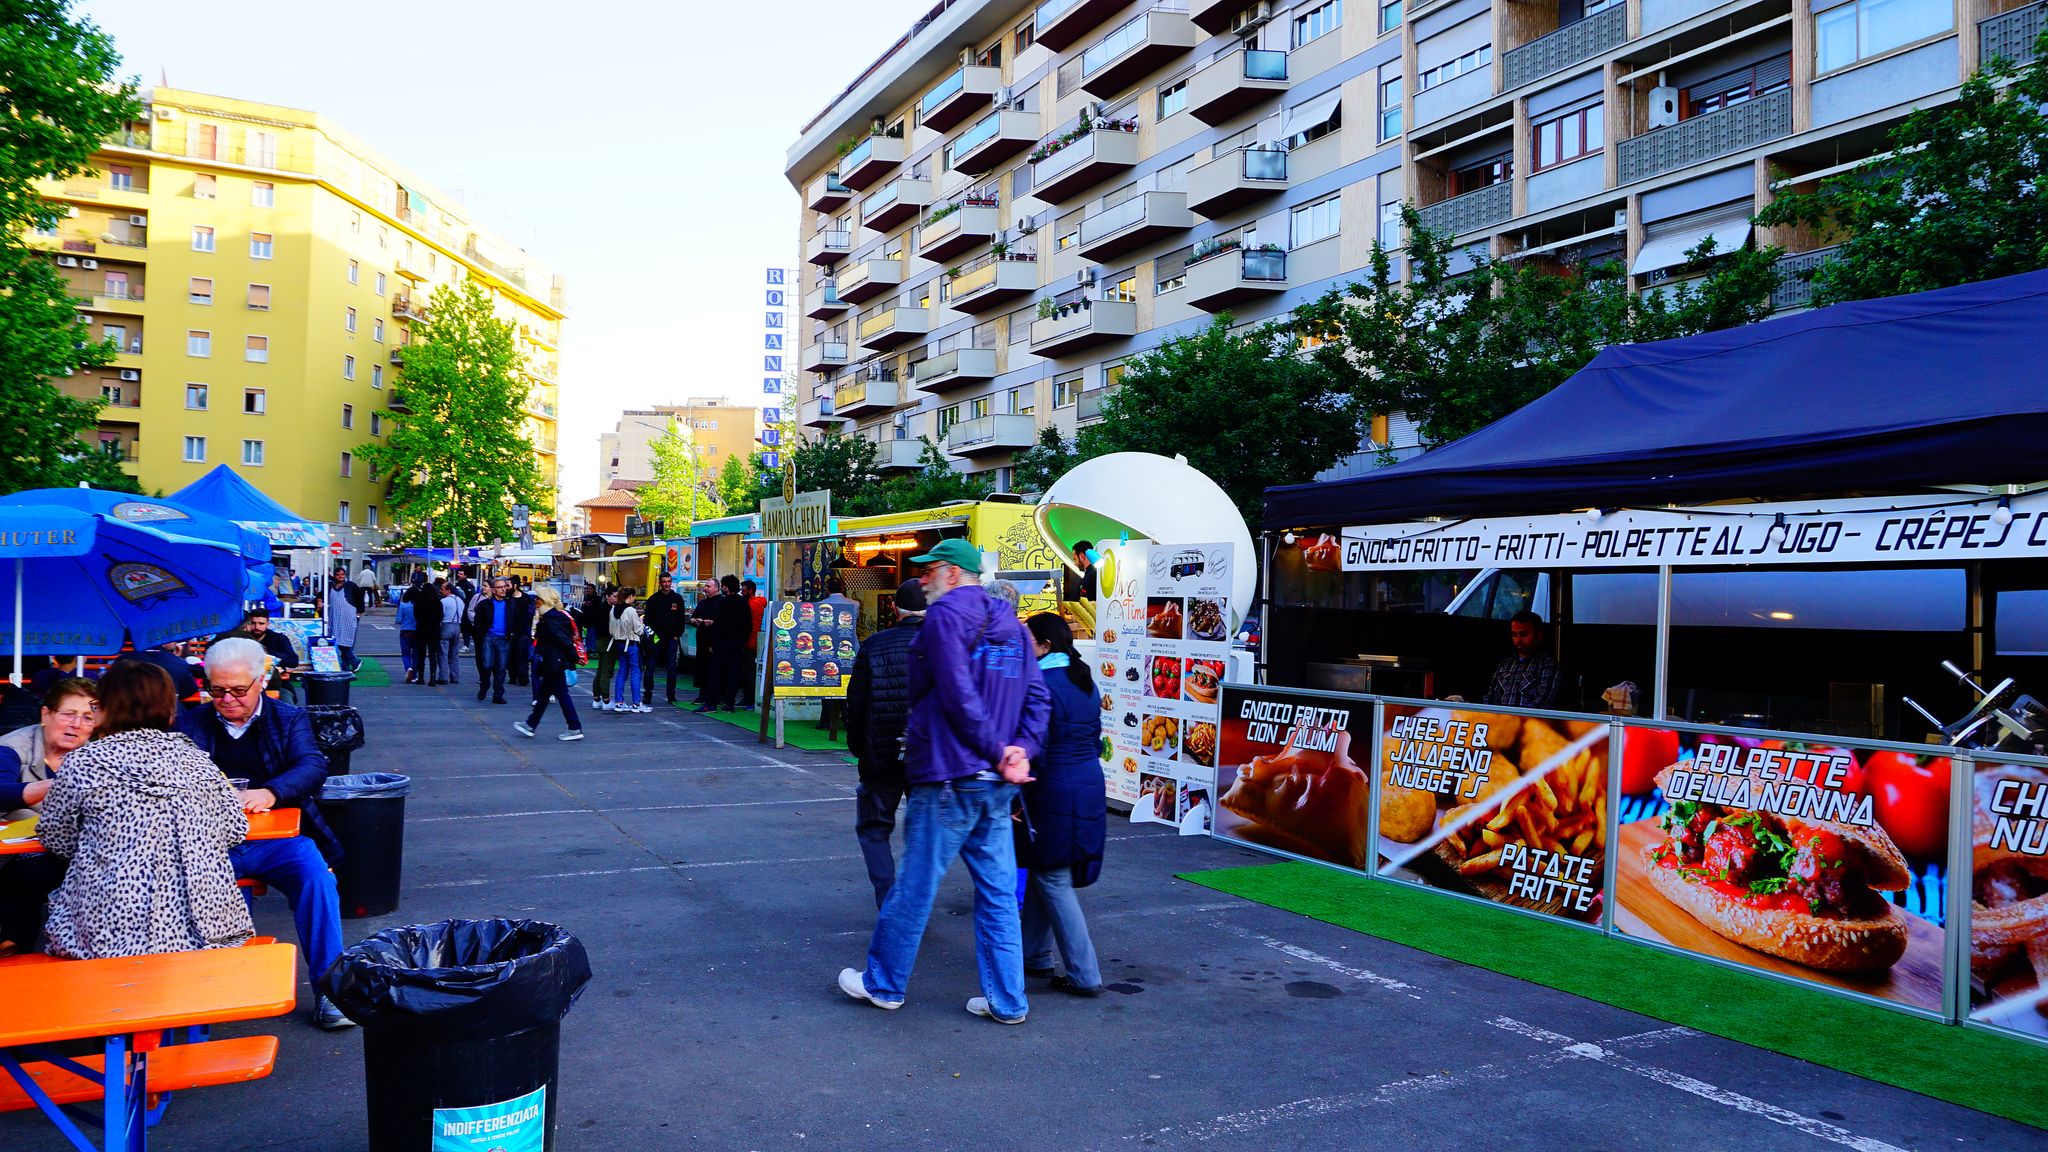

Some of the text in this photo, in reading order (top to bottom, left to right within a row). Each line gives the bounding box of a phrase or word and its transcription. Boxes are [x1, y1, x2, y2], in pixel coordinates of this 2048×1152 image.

[764, 268, 784, 393] ROMANA
[762, 505, 827, 538] HAMBURGHERIA
[1581, 526, 1711, 559] POLPETTE
[1711, 525, 1745, 555] AL
[1240, 699, 1350, 732] GNOCCO FRITTO
[1391, 715, 1489, 748] CHEESE &
[1279, 726, 1340, 754] SALUMI
[1390, 739, 1493, 774] JALAPENO
[1389, 763, 1490, 799] NUGGETS
[1692, 742, 1851, 788] POLPETTE
[1666, 770, 1875, 827] DELLA NONNA
[1990, 779, 2048, 819] CH
[1499, 842, 1595, 884] PATATE
[1508, 871, 1594, 912] FRITTE
[443, 1103, 539, 1136] INDIFFERENZIATA
